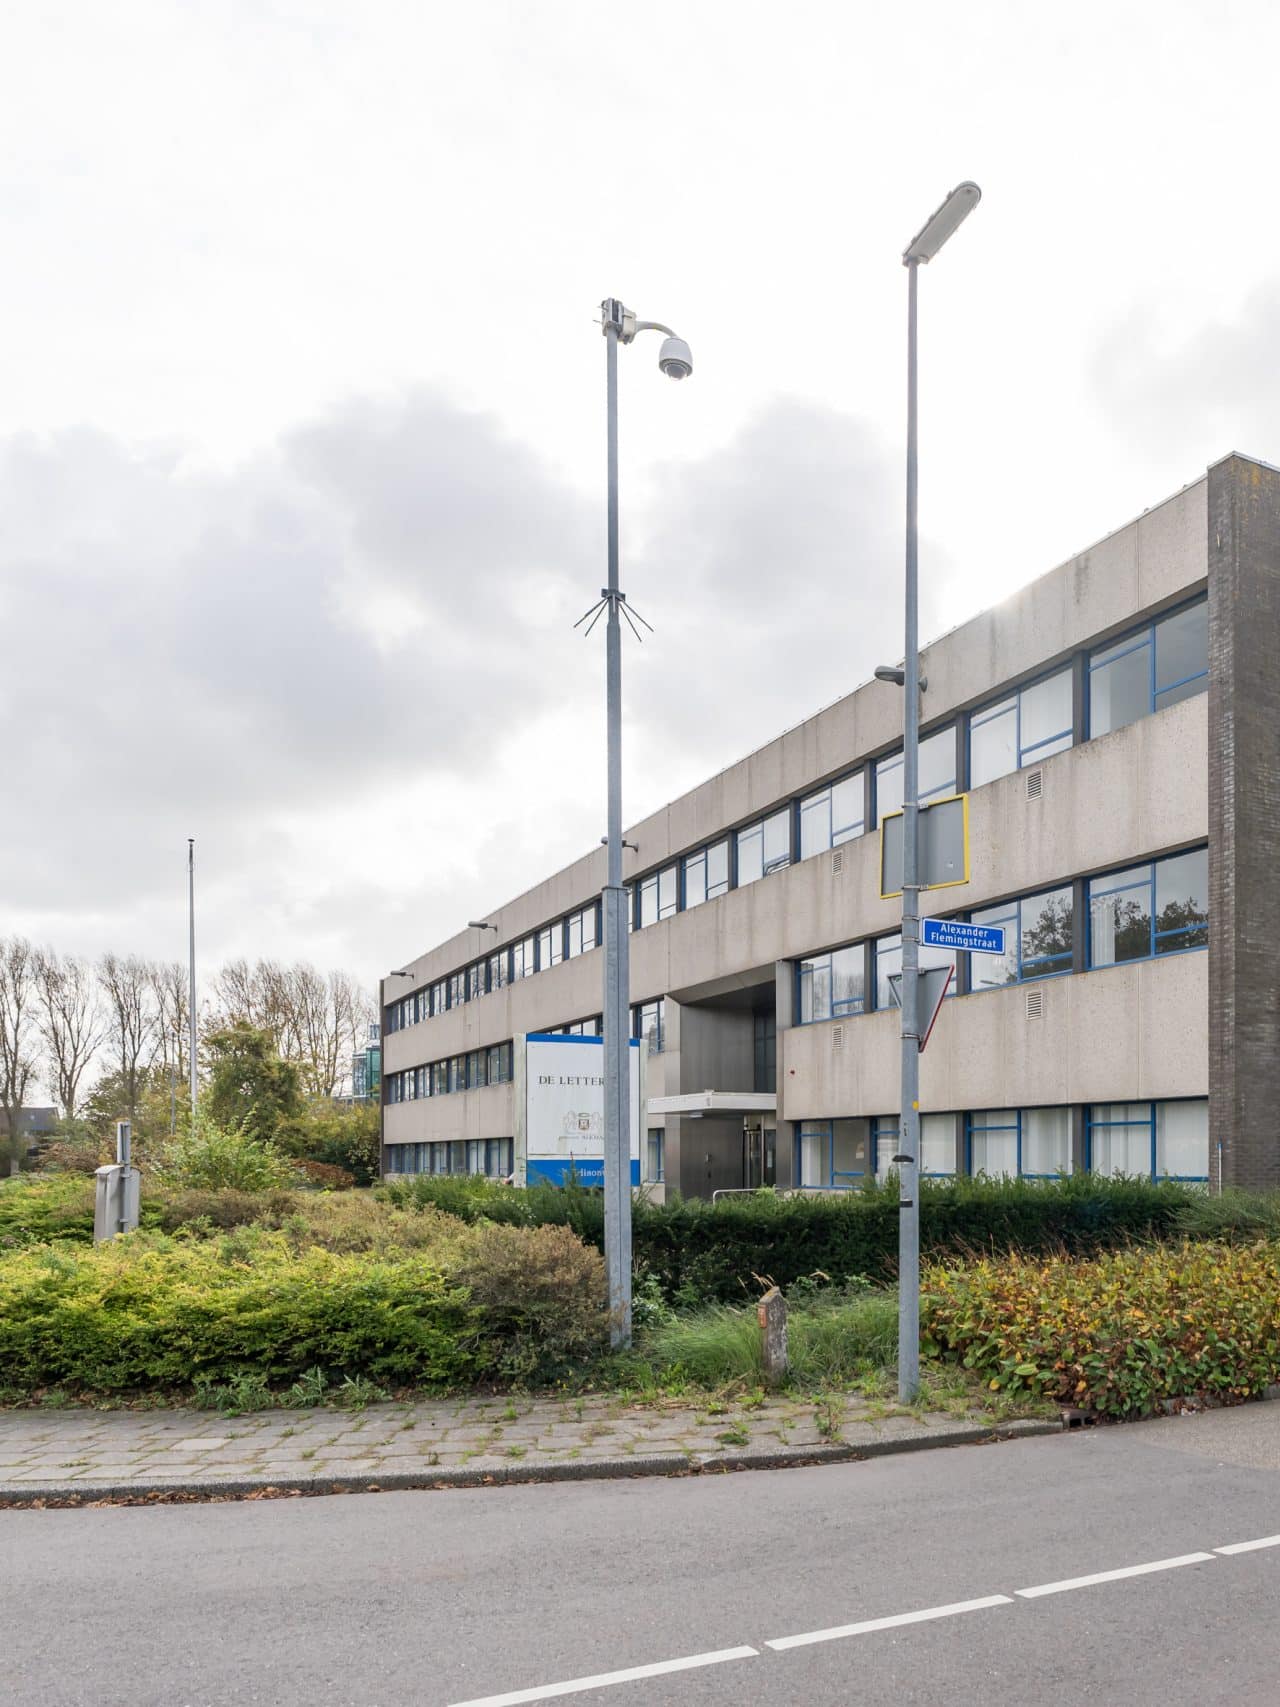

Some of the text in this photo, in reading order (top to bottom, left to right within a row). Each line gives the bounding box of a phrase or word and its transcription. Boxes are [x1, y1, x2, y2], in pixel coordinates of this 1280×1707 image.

[940, 923, 988, 937] Alexander
[931, 931, 997, 948] Flemingstraat
[539, 1075, 555, 1085] DE
